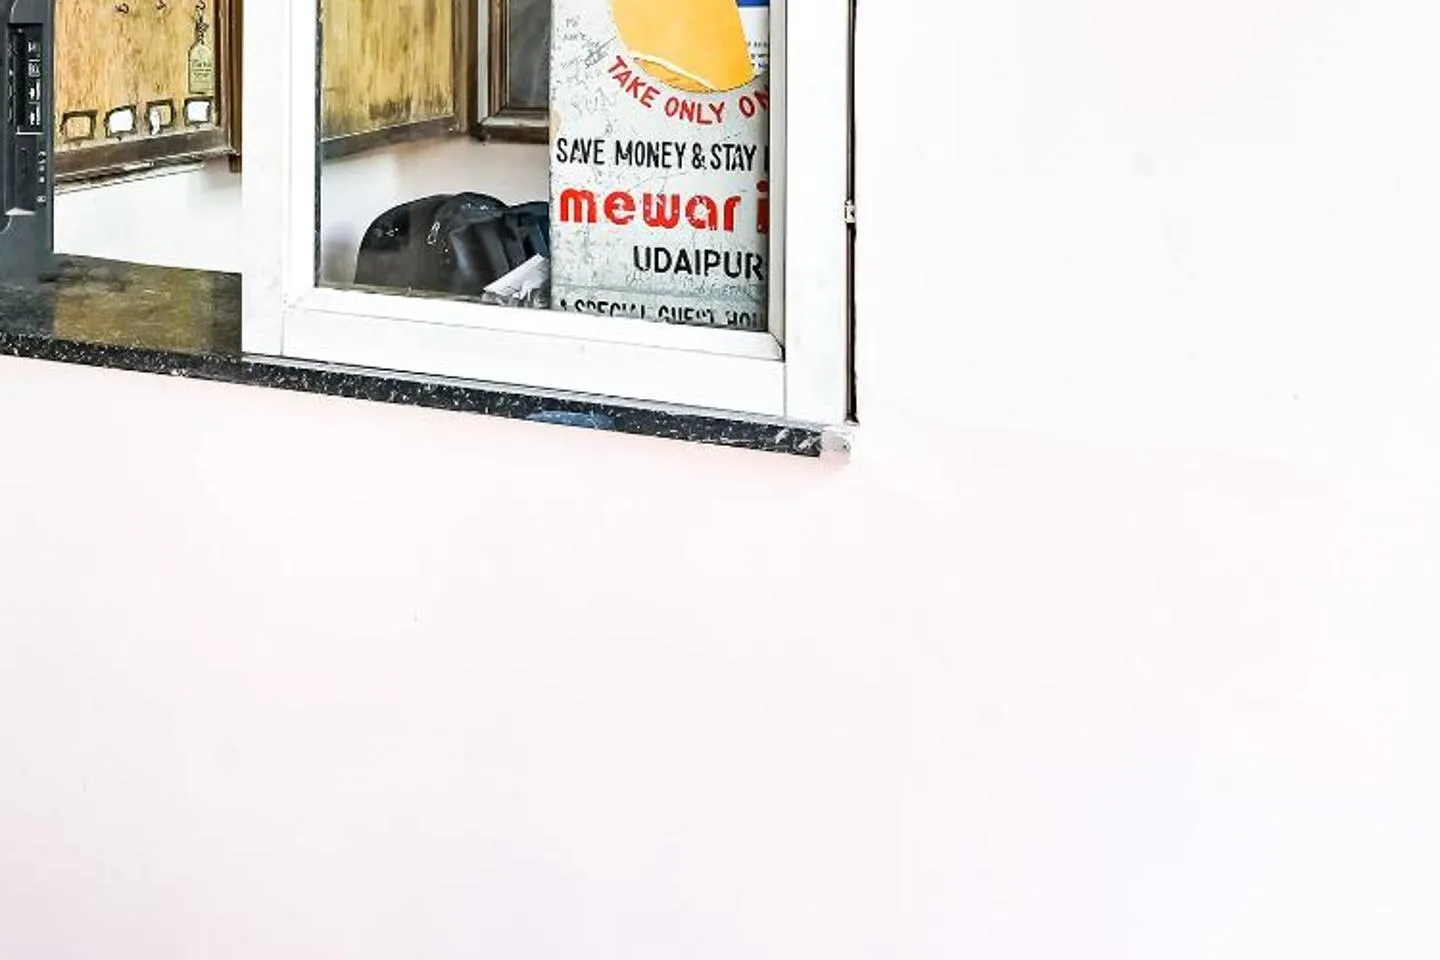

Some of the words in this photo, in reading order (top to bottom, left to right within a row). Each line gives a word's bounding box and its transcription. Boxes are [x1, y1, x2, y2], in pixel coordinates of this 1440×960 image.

[608, 55, 660, 109] TAKE
[664, 97, 725, 125] ONLY
[556, 138, 606, 166] SAVE
[615, 140, 686, 169] MONEY
[692, 143, 708, 170] &
[710, 143, 757, 171] STAY
[559, 188, 742, 233] mewar
[633, 245, 765, 281] UDAIPUR
